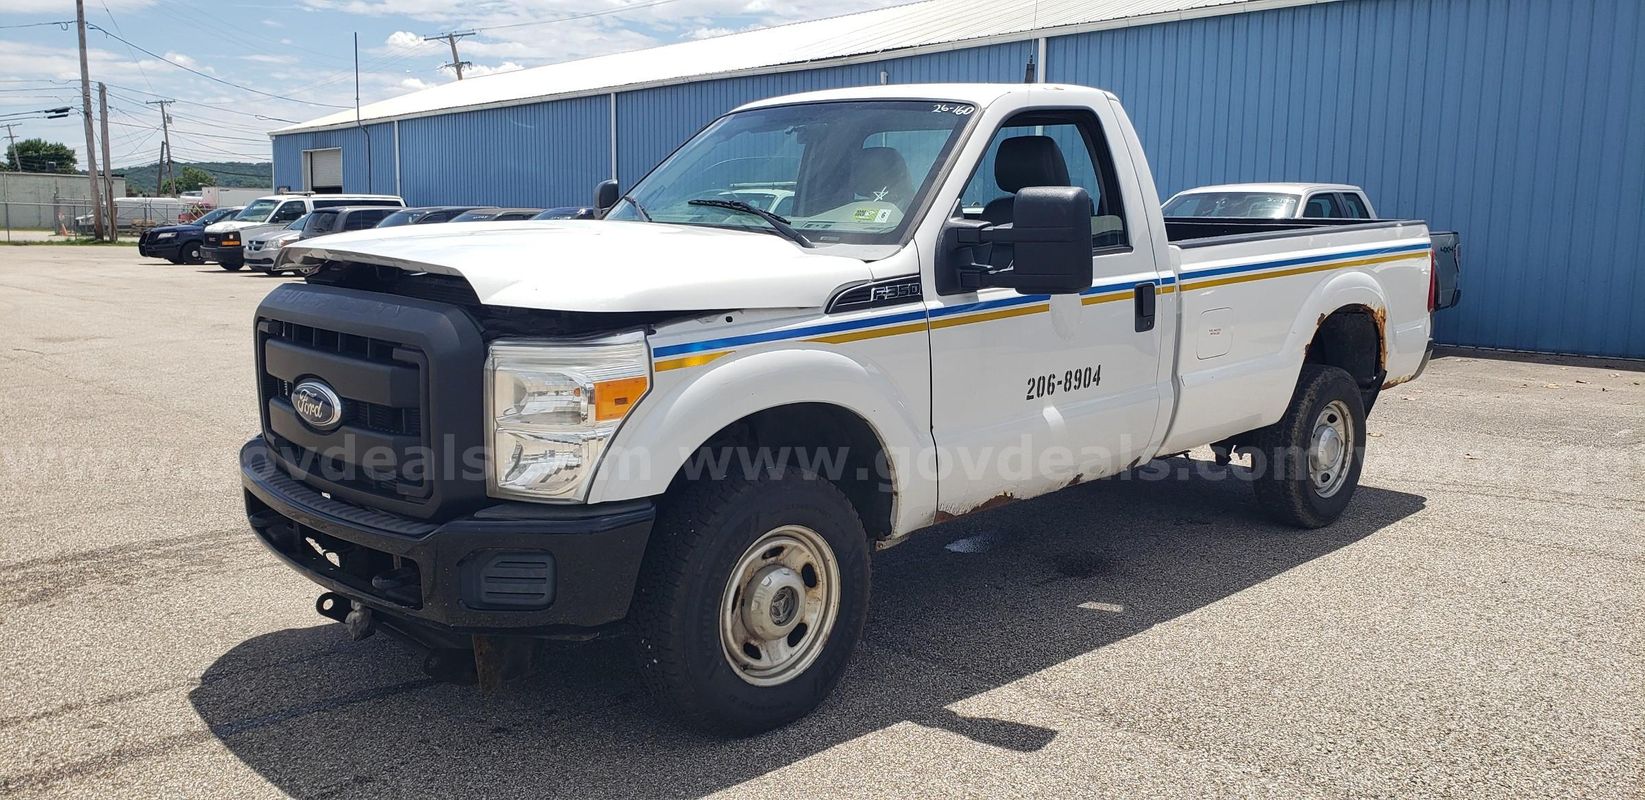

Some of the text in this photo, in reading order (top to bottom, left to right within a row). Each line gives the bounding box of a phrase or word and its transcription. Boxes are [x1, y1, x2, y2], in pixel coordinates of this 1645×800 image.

[931, 103, 975, 116] 26-160
[1026, 364, 1102, 401] 206-8904
[297, 388, 324, 418] Ford
